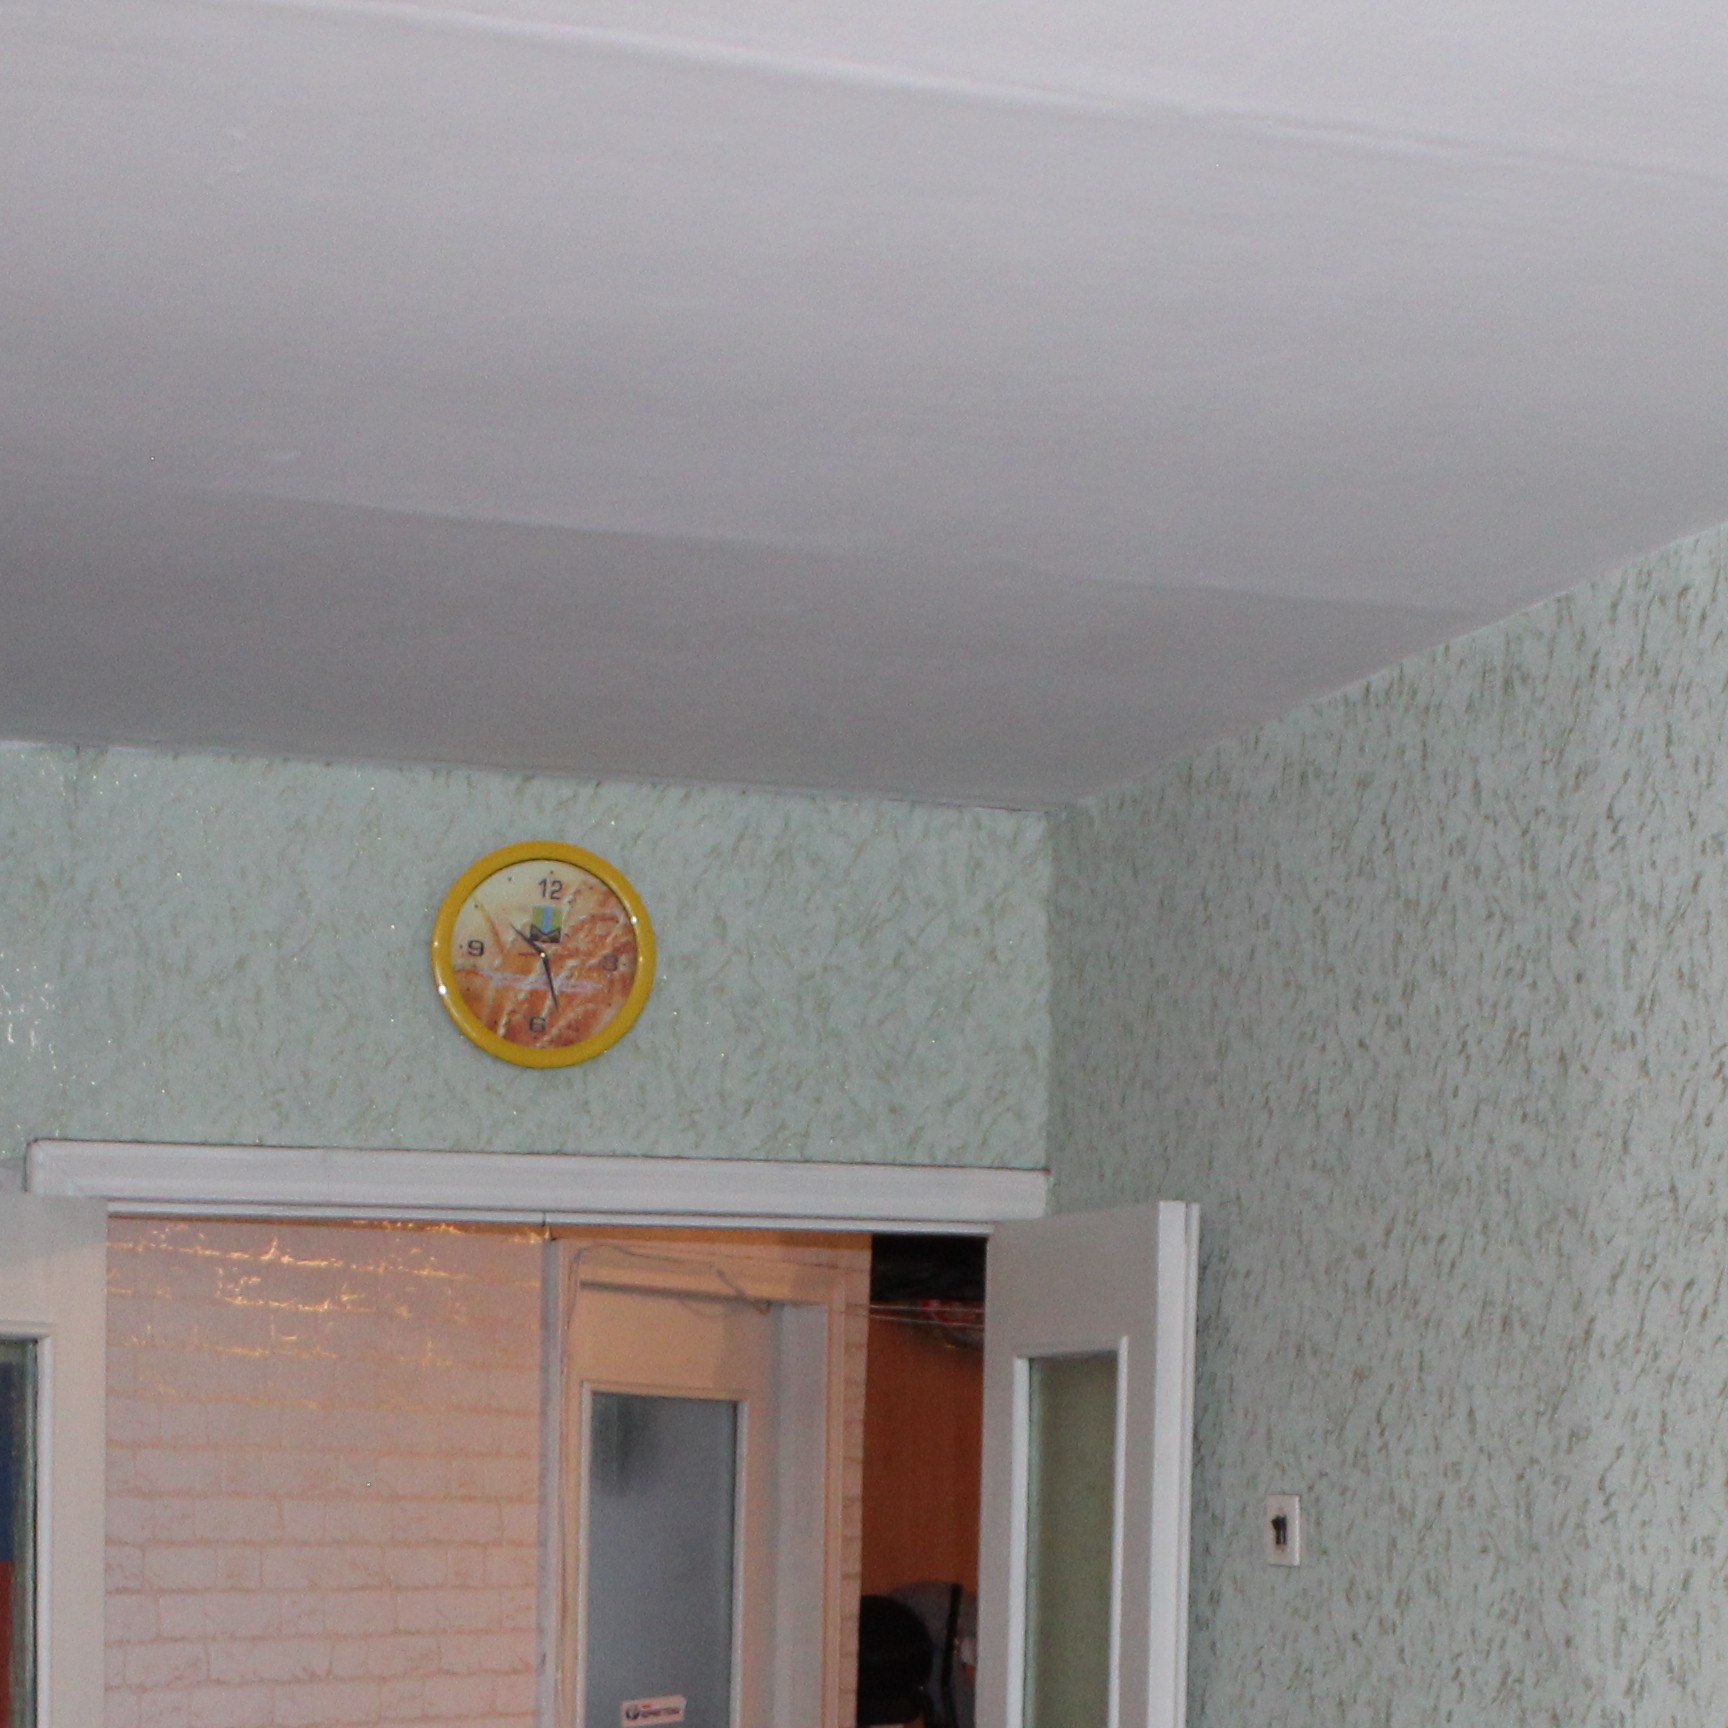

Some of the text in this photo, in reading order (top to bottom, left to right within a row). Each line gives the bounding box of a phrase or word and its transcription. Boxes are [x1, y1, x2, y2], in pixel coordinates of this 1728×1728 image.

[538, 878, 563, 900] 12
[467, 939, 485, 957] 9
[528, 1016, 546, 1033] 6
